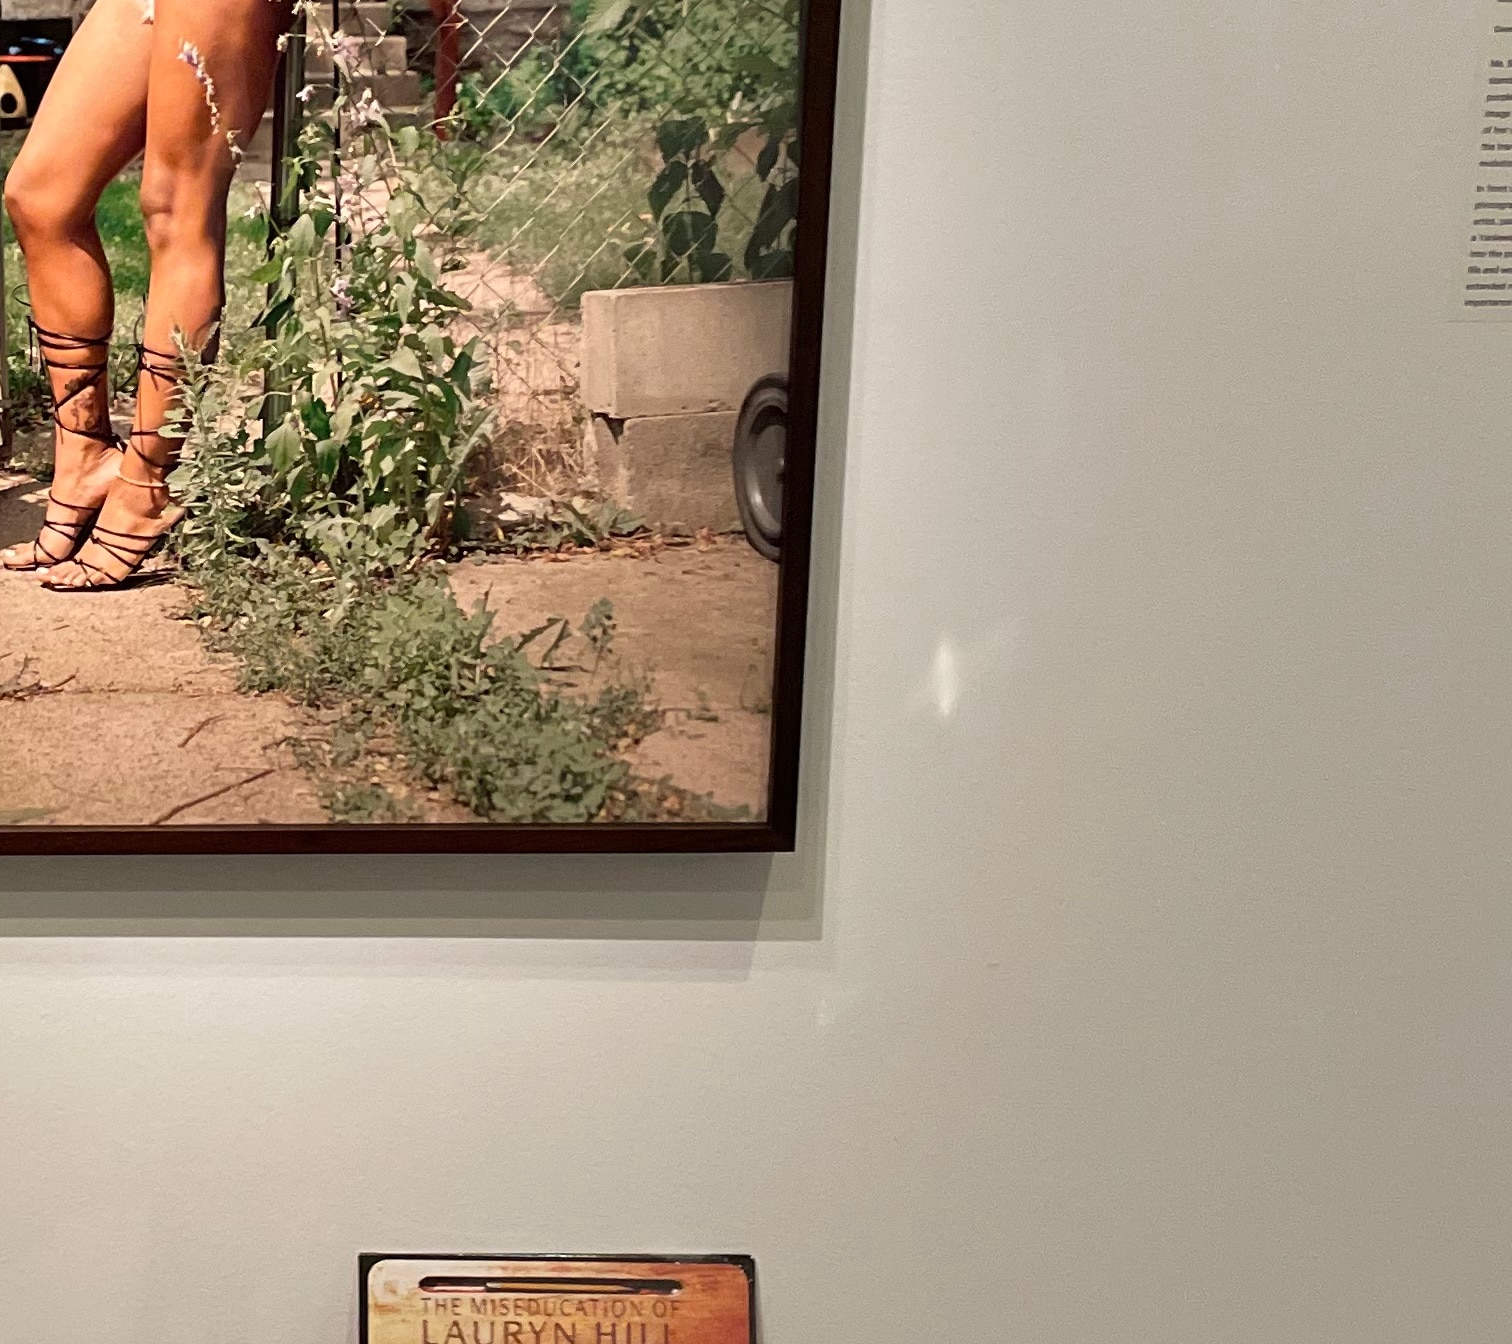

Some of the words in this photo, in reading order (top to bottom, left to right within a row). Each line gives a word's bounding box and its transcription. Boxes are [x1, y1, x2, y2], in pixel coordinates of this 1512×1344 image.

[420, 1297, 461, 1316] THE
[470, 1297, 641, 1318] MISEDUCATION
[652, 1299, 682, 1318] OF
